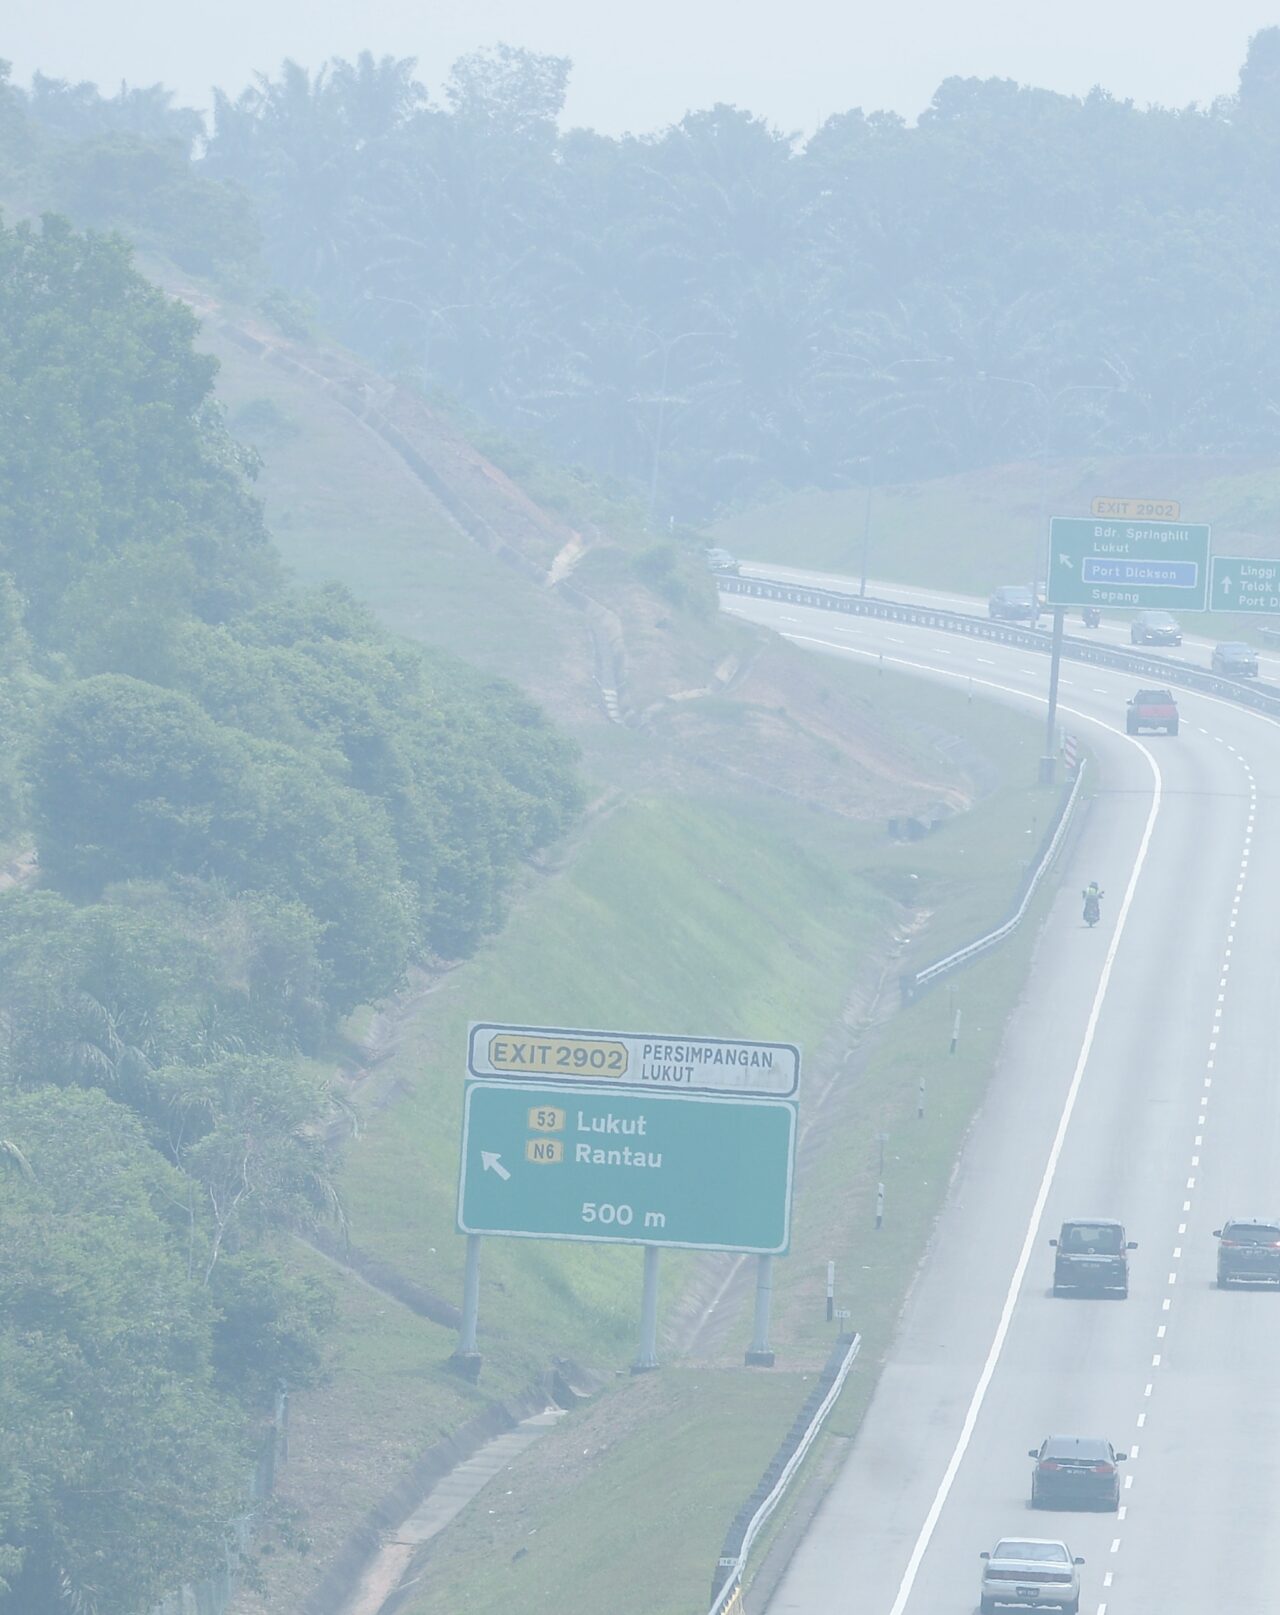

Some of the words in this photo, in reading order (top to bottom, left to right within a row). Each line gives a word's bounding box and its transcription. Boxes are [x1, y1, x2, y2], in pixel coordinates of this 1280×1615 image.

[1097, 501, 1130, 514] EXIT
[1136, 503, 1173, 517] 2902
[1094, 526, 1120, 538] Bdr.
[1125, 527, 1189, 542] Springhill
[1093, 542, 1130, 553] Lukut
[1092, 565, 1120, 577] Port
[1125, 567, 1177, 580] Dickson
[1240, 565, 1276, 579] Linggi
[1240, 580, 1273, 592] Telok
[1092, 588, 1140, 604] Sepang
[1239, 595, 1265, 606] Port
[493, 1042, 553, 1065] EXIT
[556, 1047, 624, 1071] 2902
[642, 1044, 773, 1069] PERSIMPANGAN
[641, 1065, 694, 1083] LUKUT
[537, 1111, 556, 1128] 53
[577, 1111, 647, 1136] Lukut
[533, 1143, 555, 1160] N6
[575, 1143, 663, 1169] Rantau
[581, 1203, 633, 1226] 500
[644, 1210, 666, 1228] m
